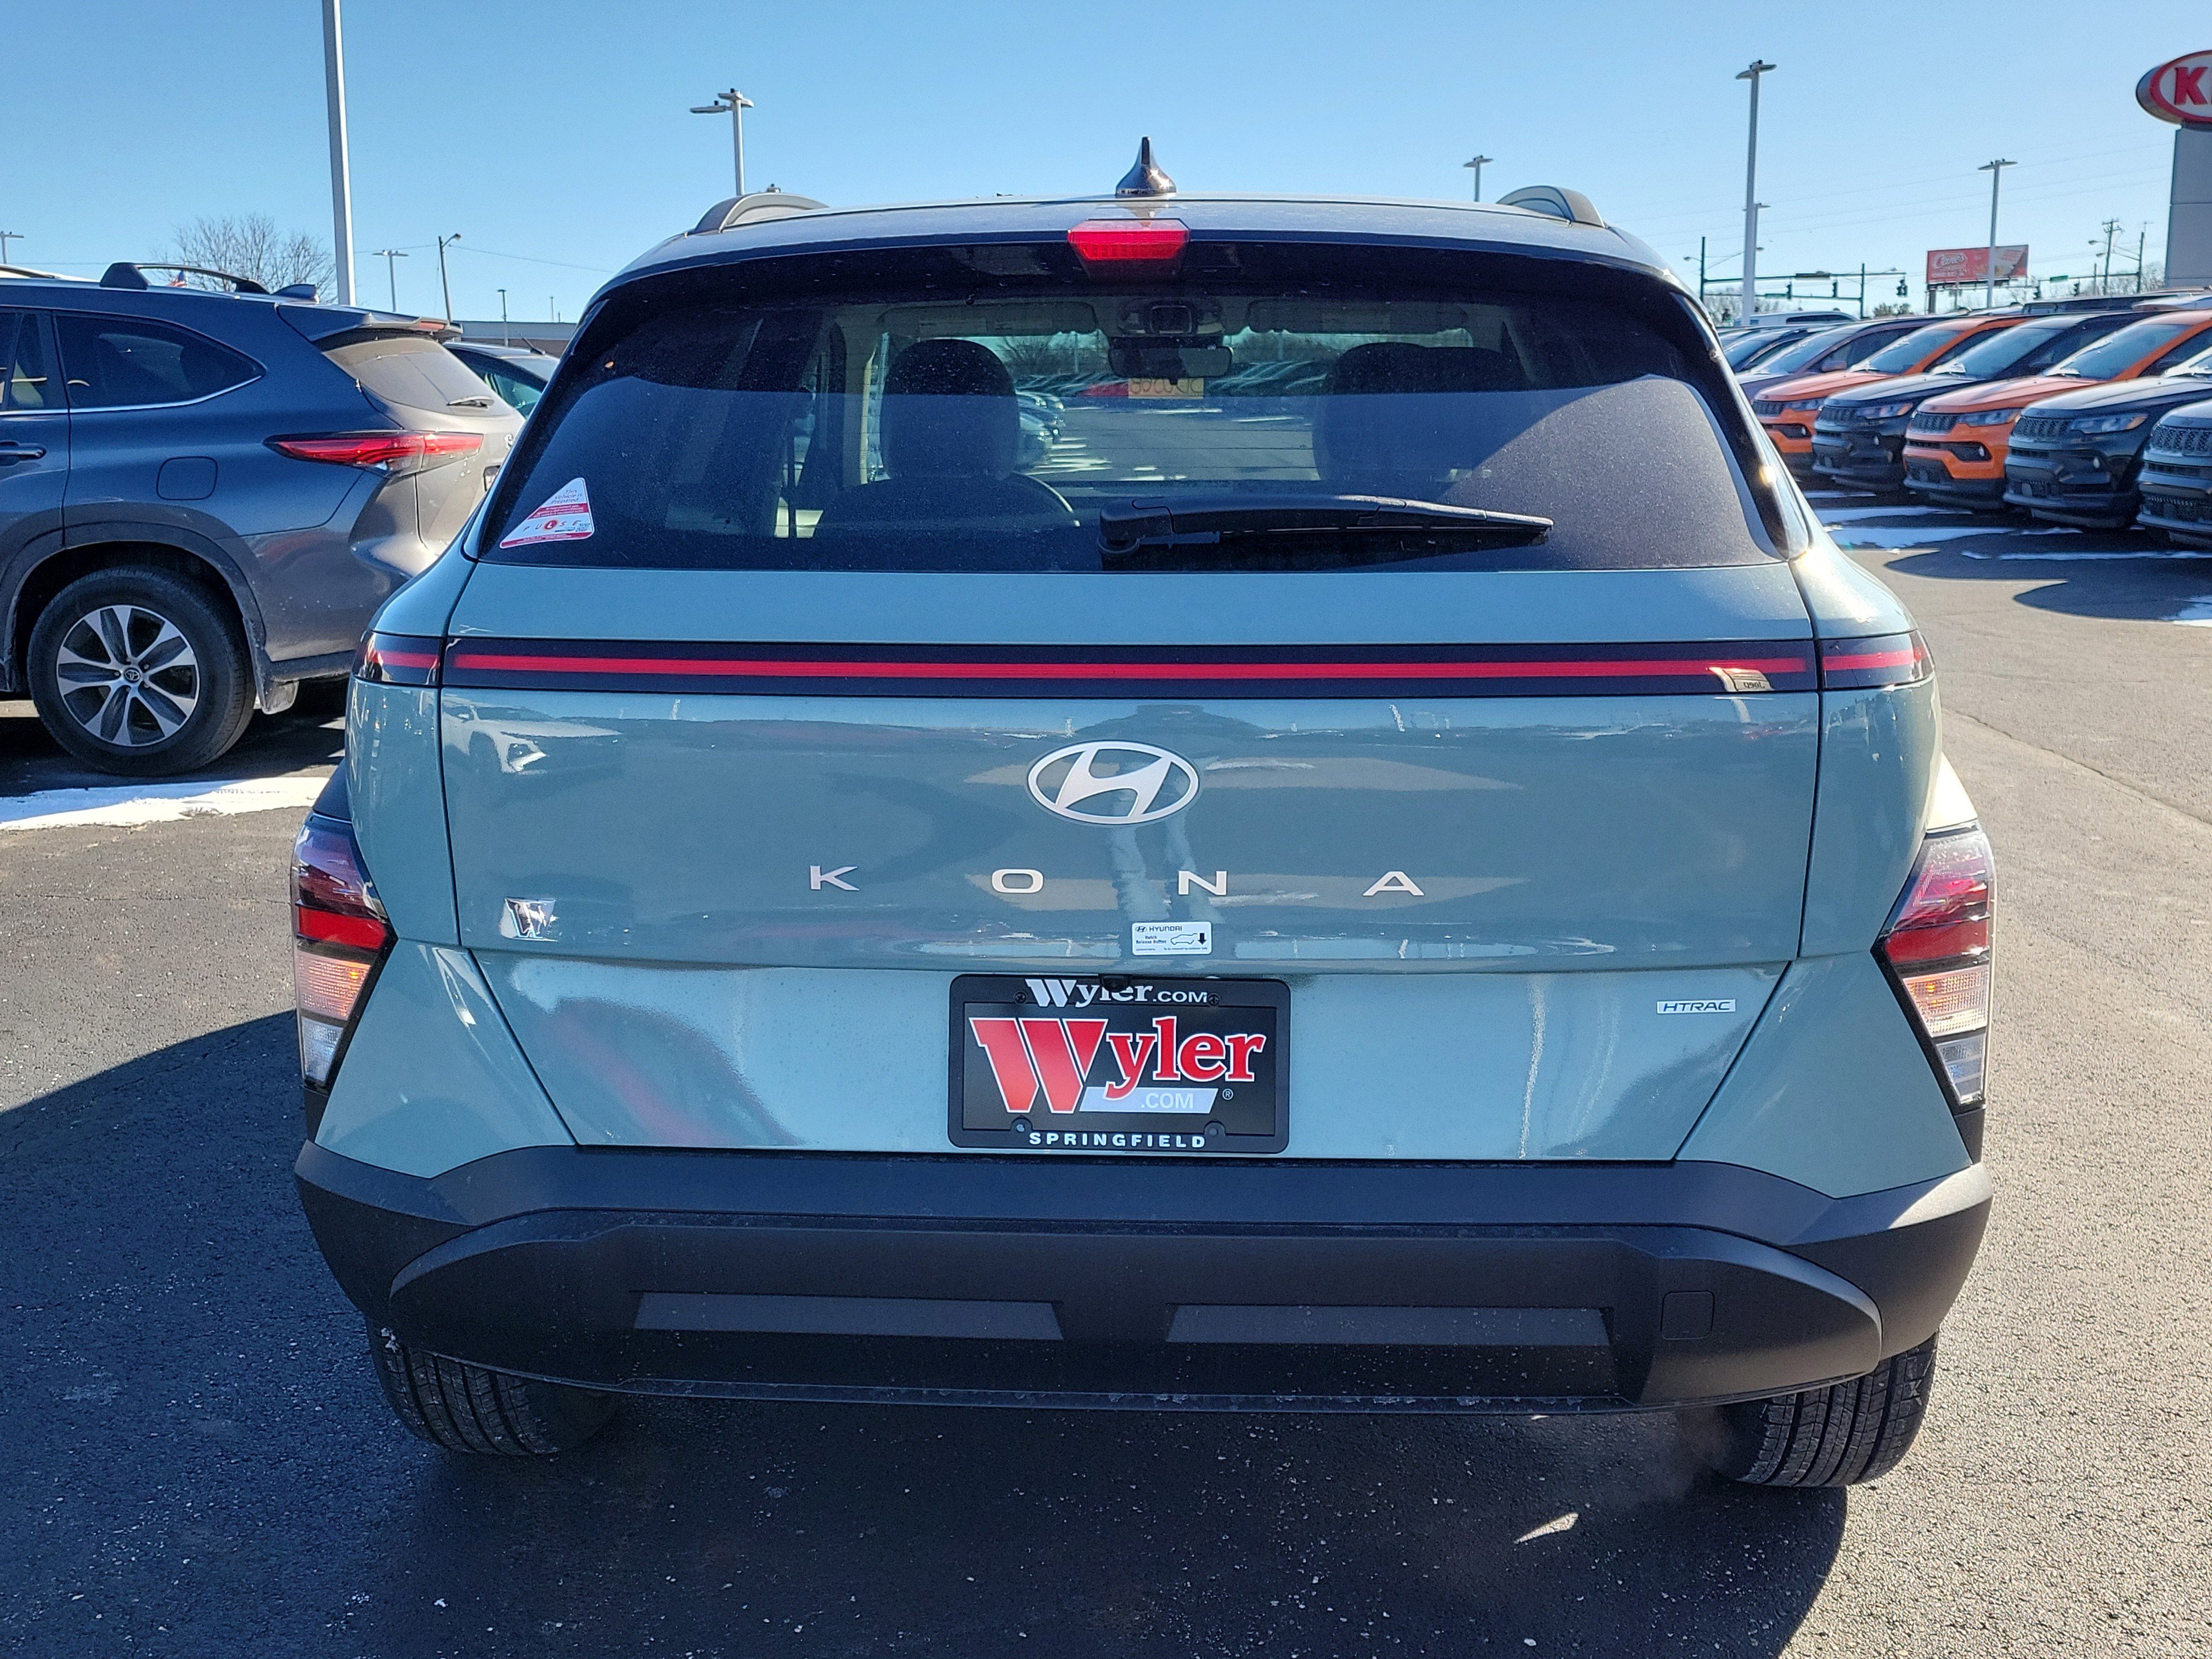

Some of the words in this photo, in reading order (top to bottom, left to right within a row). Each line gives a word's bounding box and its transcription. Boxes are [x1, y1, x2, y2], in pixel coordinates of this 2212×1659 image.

[2174, 66, 2212, 105] K
[1663, 1001, 1730, 1012] HTRAC
[969, 1015, 1266, 1114] Wyler
[1029, 1132, 1206, 1149] SPRINGFIELD
